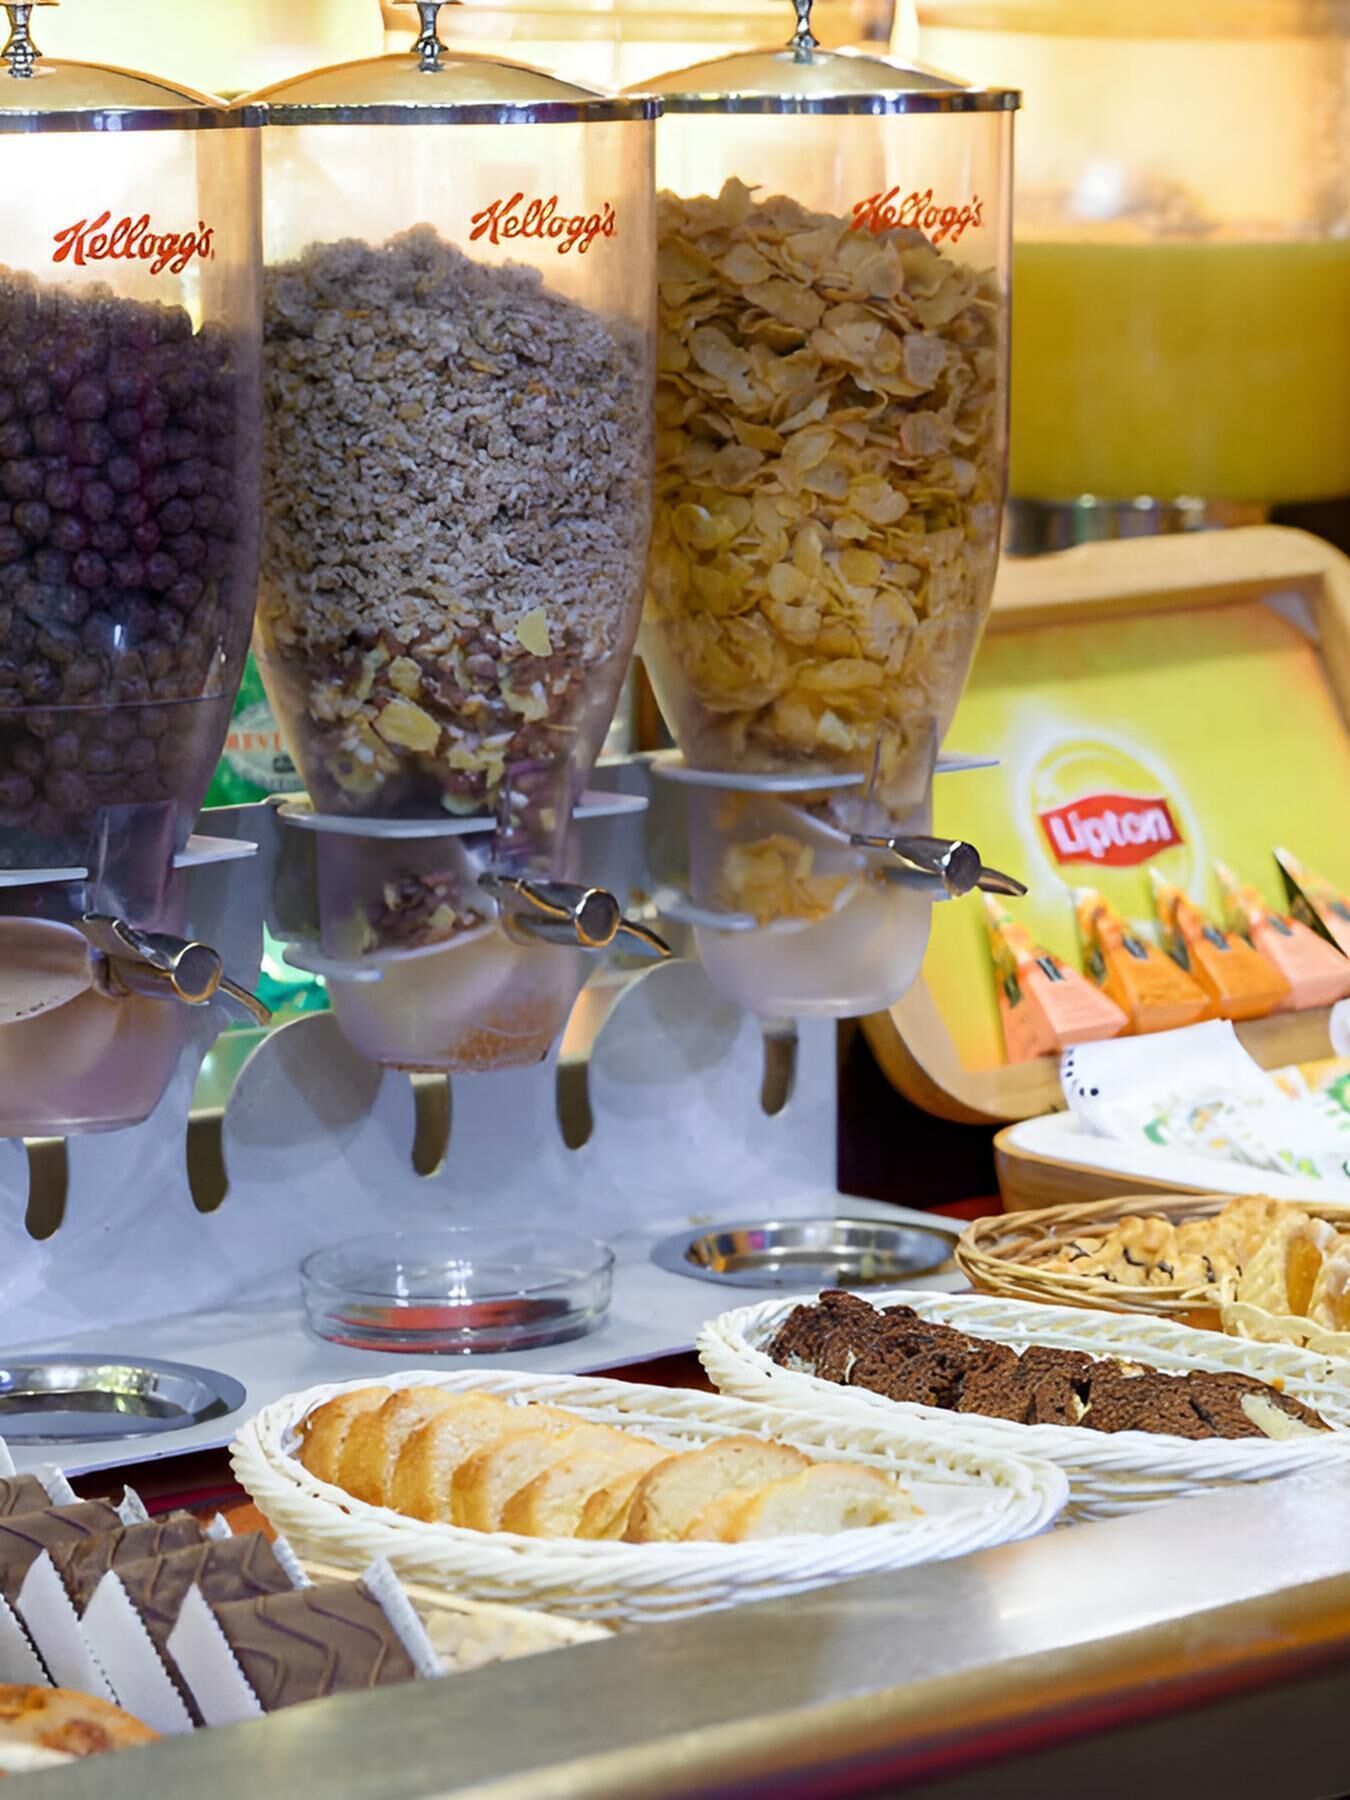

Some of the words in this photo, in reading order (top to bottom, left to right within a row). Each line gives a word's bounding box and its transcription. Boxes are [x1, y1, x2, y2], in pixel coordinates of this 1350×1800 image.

[52, 210, 214, 275] Kellogg's
[469, 192, 616, 254] Kellogg's
[852, 186, 983, 243] Kellogg's
[1049, 807, 1172, 858] Lipton
